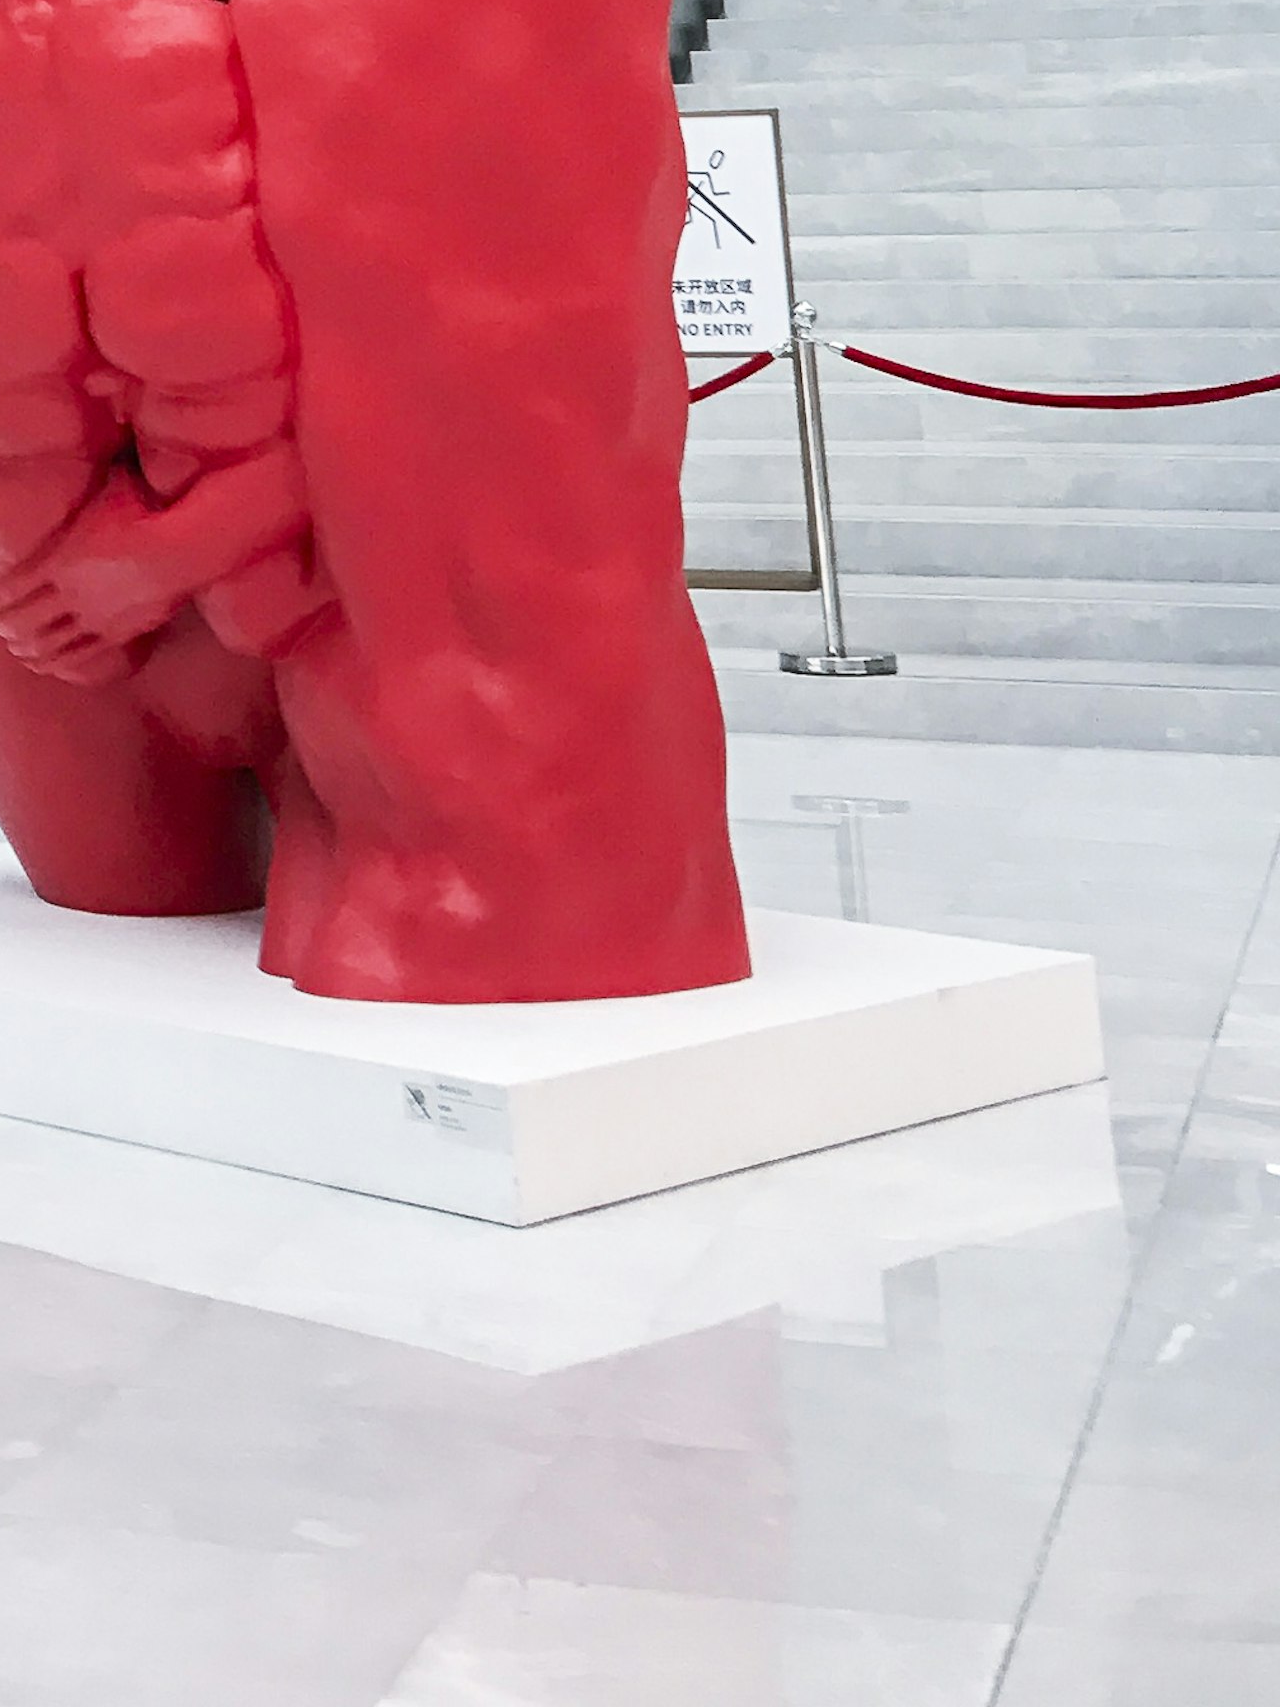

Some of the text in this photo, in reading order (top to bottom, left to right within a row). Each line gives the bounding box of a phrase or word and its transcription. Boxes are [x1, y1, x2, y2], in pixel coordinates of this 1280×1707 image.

[681, 299, 746, 314] 请勿入内
[703, 323, 753, 336] ENTRY
